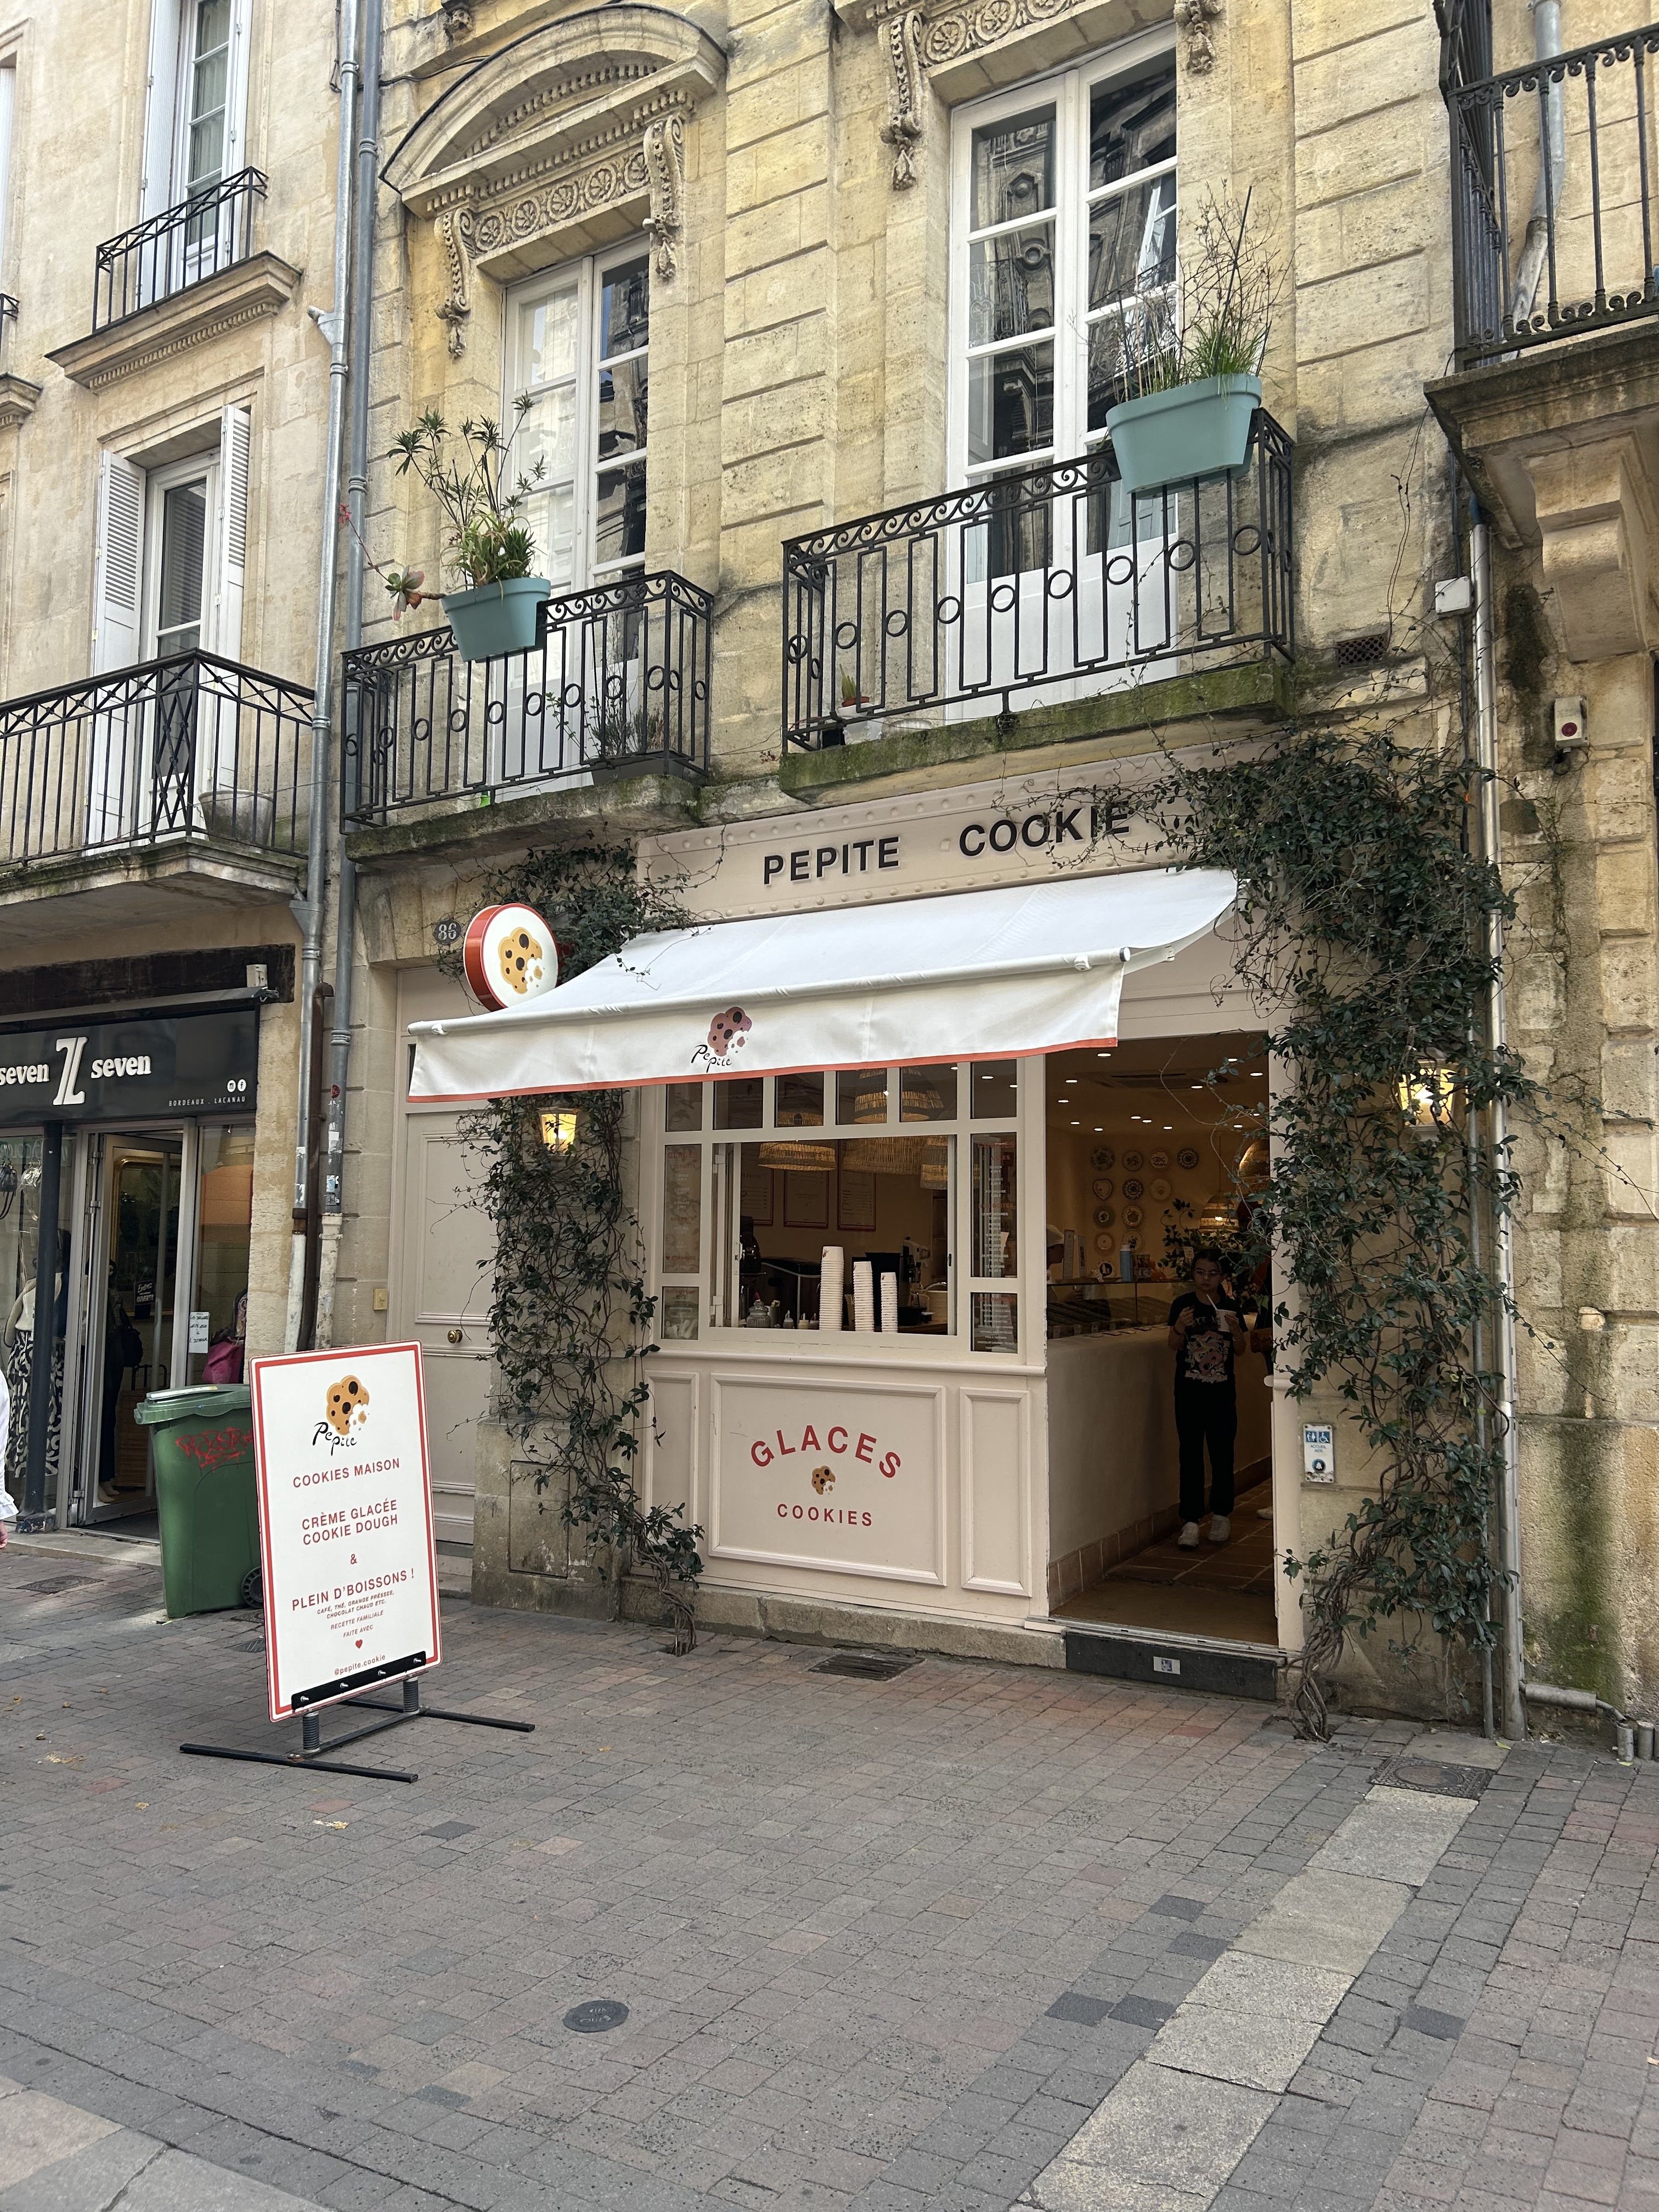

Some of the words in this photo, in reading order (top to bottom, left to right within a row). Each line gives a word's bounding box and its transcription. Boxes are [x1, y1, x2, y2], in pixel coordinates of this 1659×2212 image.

[763, 836, 900, 885] PEPITE
[959, 800, 1130, 856] COOKIE
[0, 1064, 49, 1086] seven
[91, 1054, 152, 1079] seven
[691, 1044, 732, 1074] Pepite
[168, 1098, 205, 1107] BORDEAUX
[214, 1096, 246, 1104] LACANAU
[312, 1421, 358, 1456] Pepite
[751, 1425, 901, 1479] GLACES
[293, 1467, 349, 1488] COOKIES
[354, 1458, 400, 1476] MAISON
[302, 1510, 346, 1530] CRÈME
[351, 1498, 398, 1520] GLACÉE
[777, 1503, 872, 1527] COOKIES
[303, 1525, 352, 1545] COOKIE
[356, 1514, 398, 1533] DOUGH
[350, 1554, 357, 1564] &
[292, 1591, 329, 1611] PLEIN
[317, 1605, 332, 1615] CAFÉ,
[348, 1596, 369, 1606] ORANGE
[326, 1607, 355, 1619] CHOCOLAT
[356, 1602, 374, 1611] CHAUD
[330, 1618, 356, 1630] RECETTE
[357, 1610, 384, 1622] FAMILIALE
[343, 1628, 358, 1638] FAITE
[359, 1624, 374, 1633] AVEC
[334, 1654, 386, 1675] @pepite.cookie
